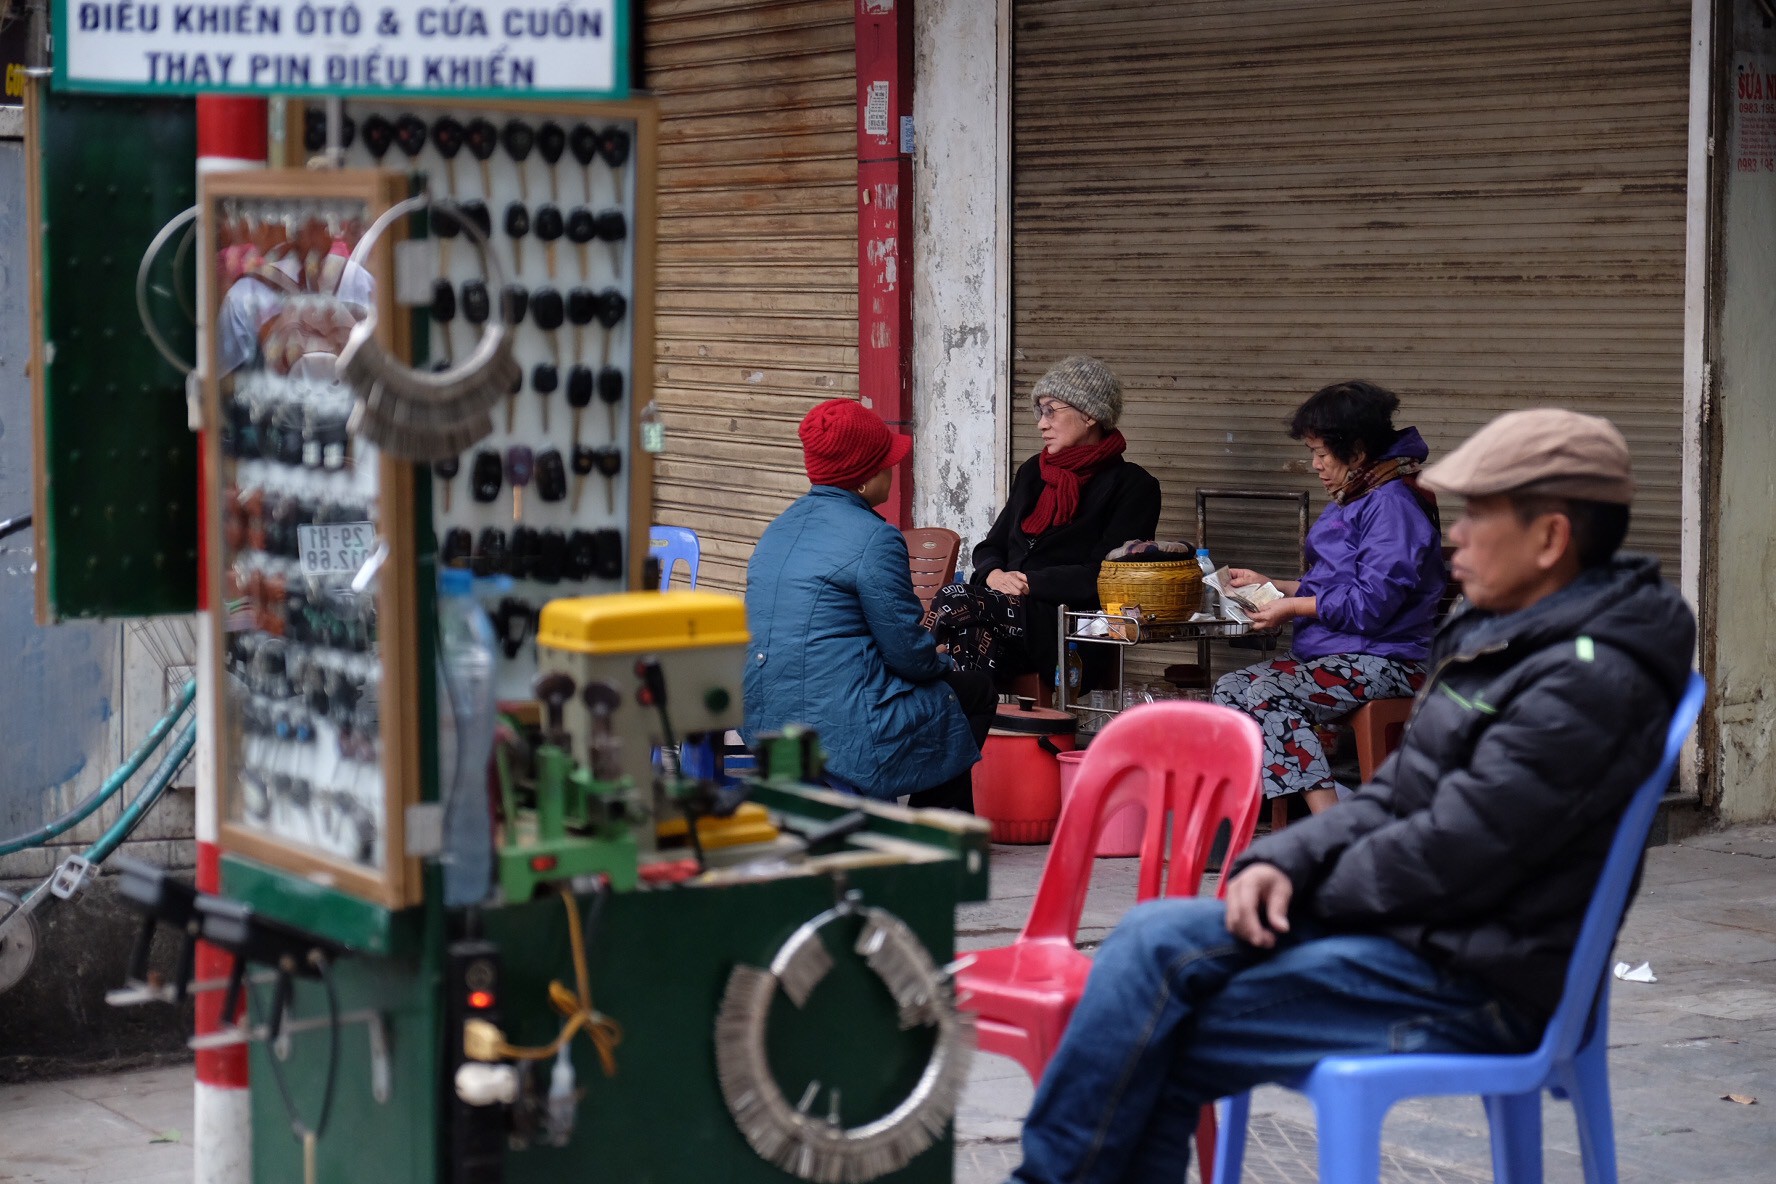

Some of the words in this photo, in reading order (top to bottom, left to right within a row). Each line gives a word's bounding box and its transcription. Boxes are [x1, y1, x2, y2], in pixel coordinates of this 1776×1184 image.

[376, 7, 400, 37] &
[144, 50, 235, 84] THAY
[250, 53, 311, 85] PIN
